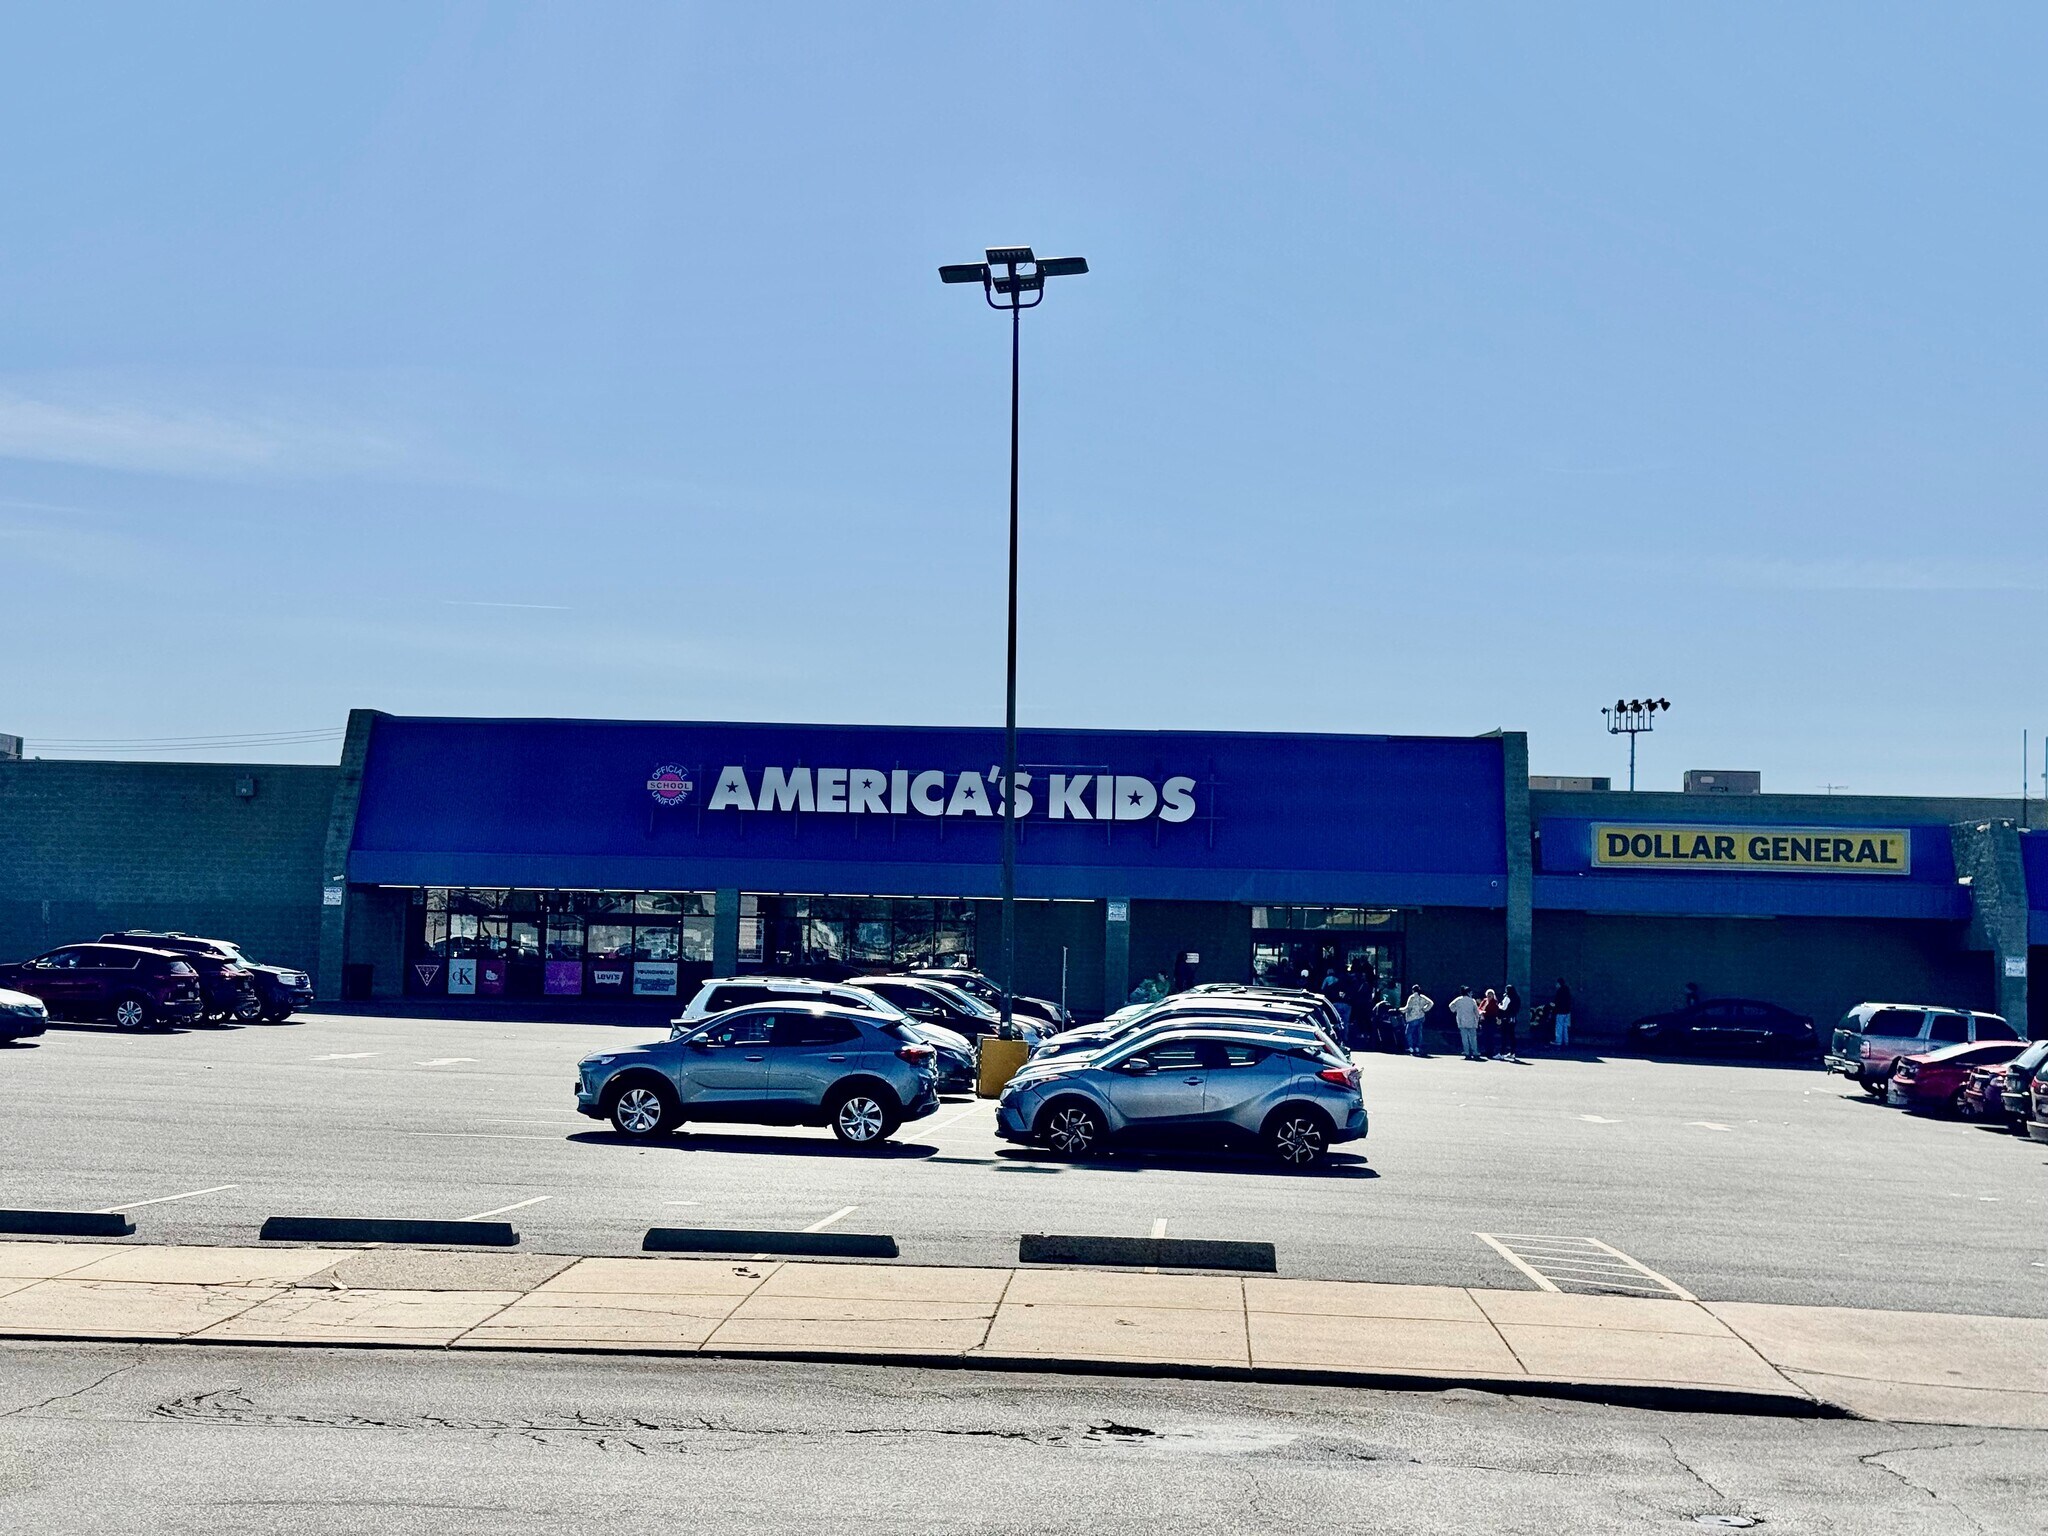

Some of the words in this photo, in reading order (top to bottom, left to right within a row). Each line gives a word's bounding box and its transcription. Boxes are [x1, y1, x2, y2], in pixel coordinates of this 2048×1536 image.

[652, 765, 687, 780] OFFICIAL
[650, 782, 690, 790] SCHOOL
[708, 765, 1033, 818] AMERICA'S
[1048, 774, 1197, 823] KIDS
[652, 790, 688, 806] UNIFORM
[1606, 833, 1736, 860] DOLLAR
[1748, 837, 1897, 864] GENERAL
